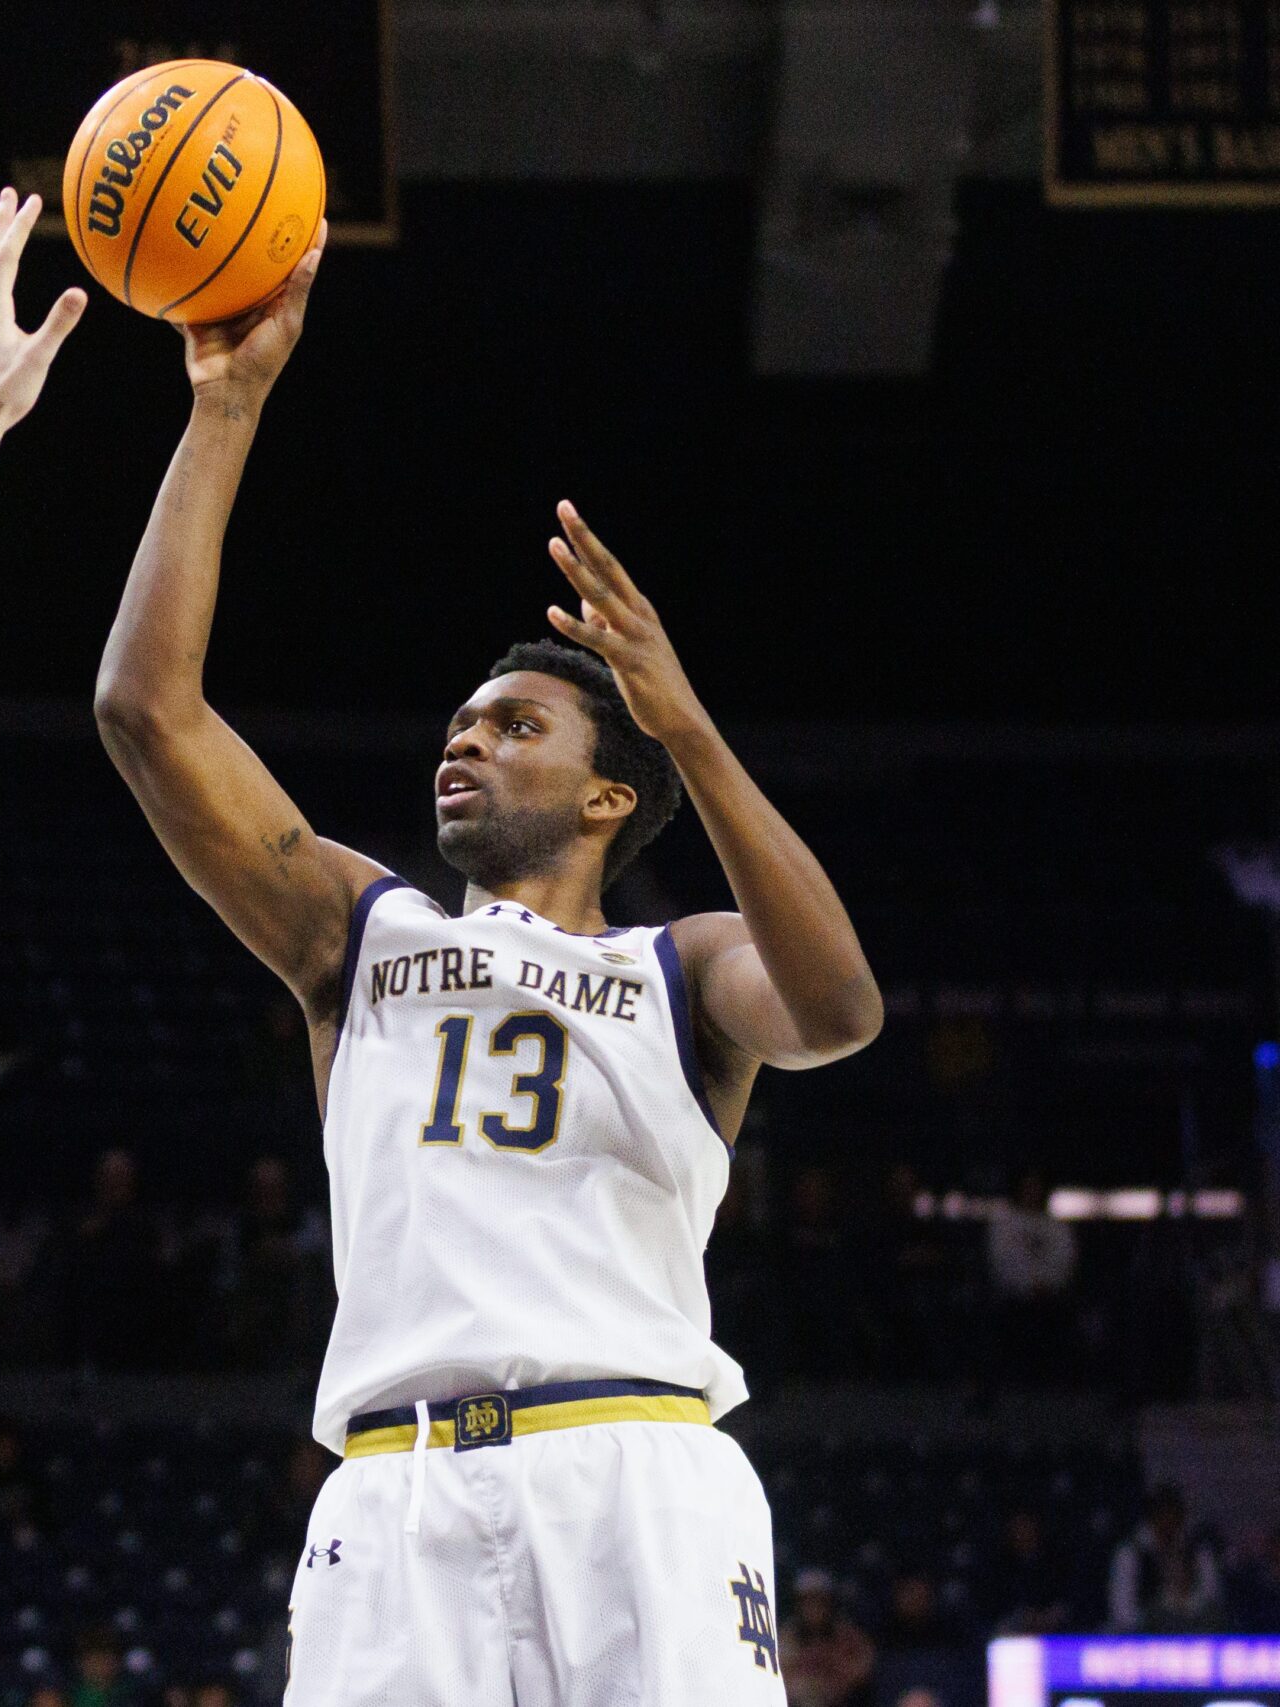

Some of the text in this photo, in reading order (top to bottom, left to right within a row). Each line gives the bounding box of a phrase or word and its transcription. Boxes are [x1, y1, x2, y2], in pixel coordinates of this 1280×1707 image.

[88, 84, 197, 237] Wilson
[371, 947, 644, 1023] NOTRE DAME
[417, 1009, 570, 1155] 13
